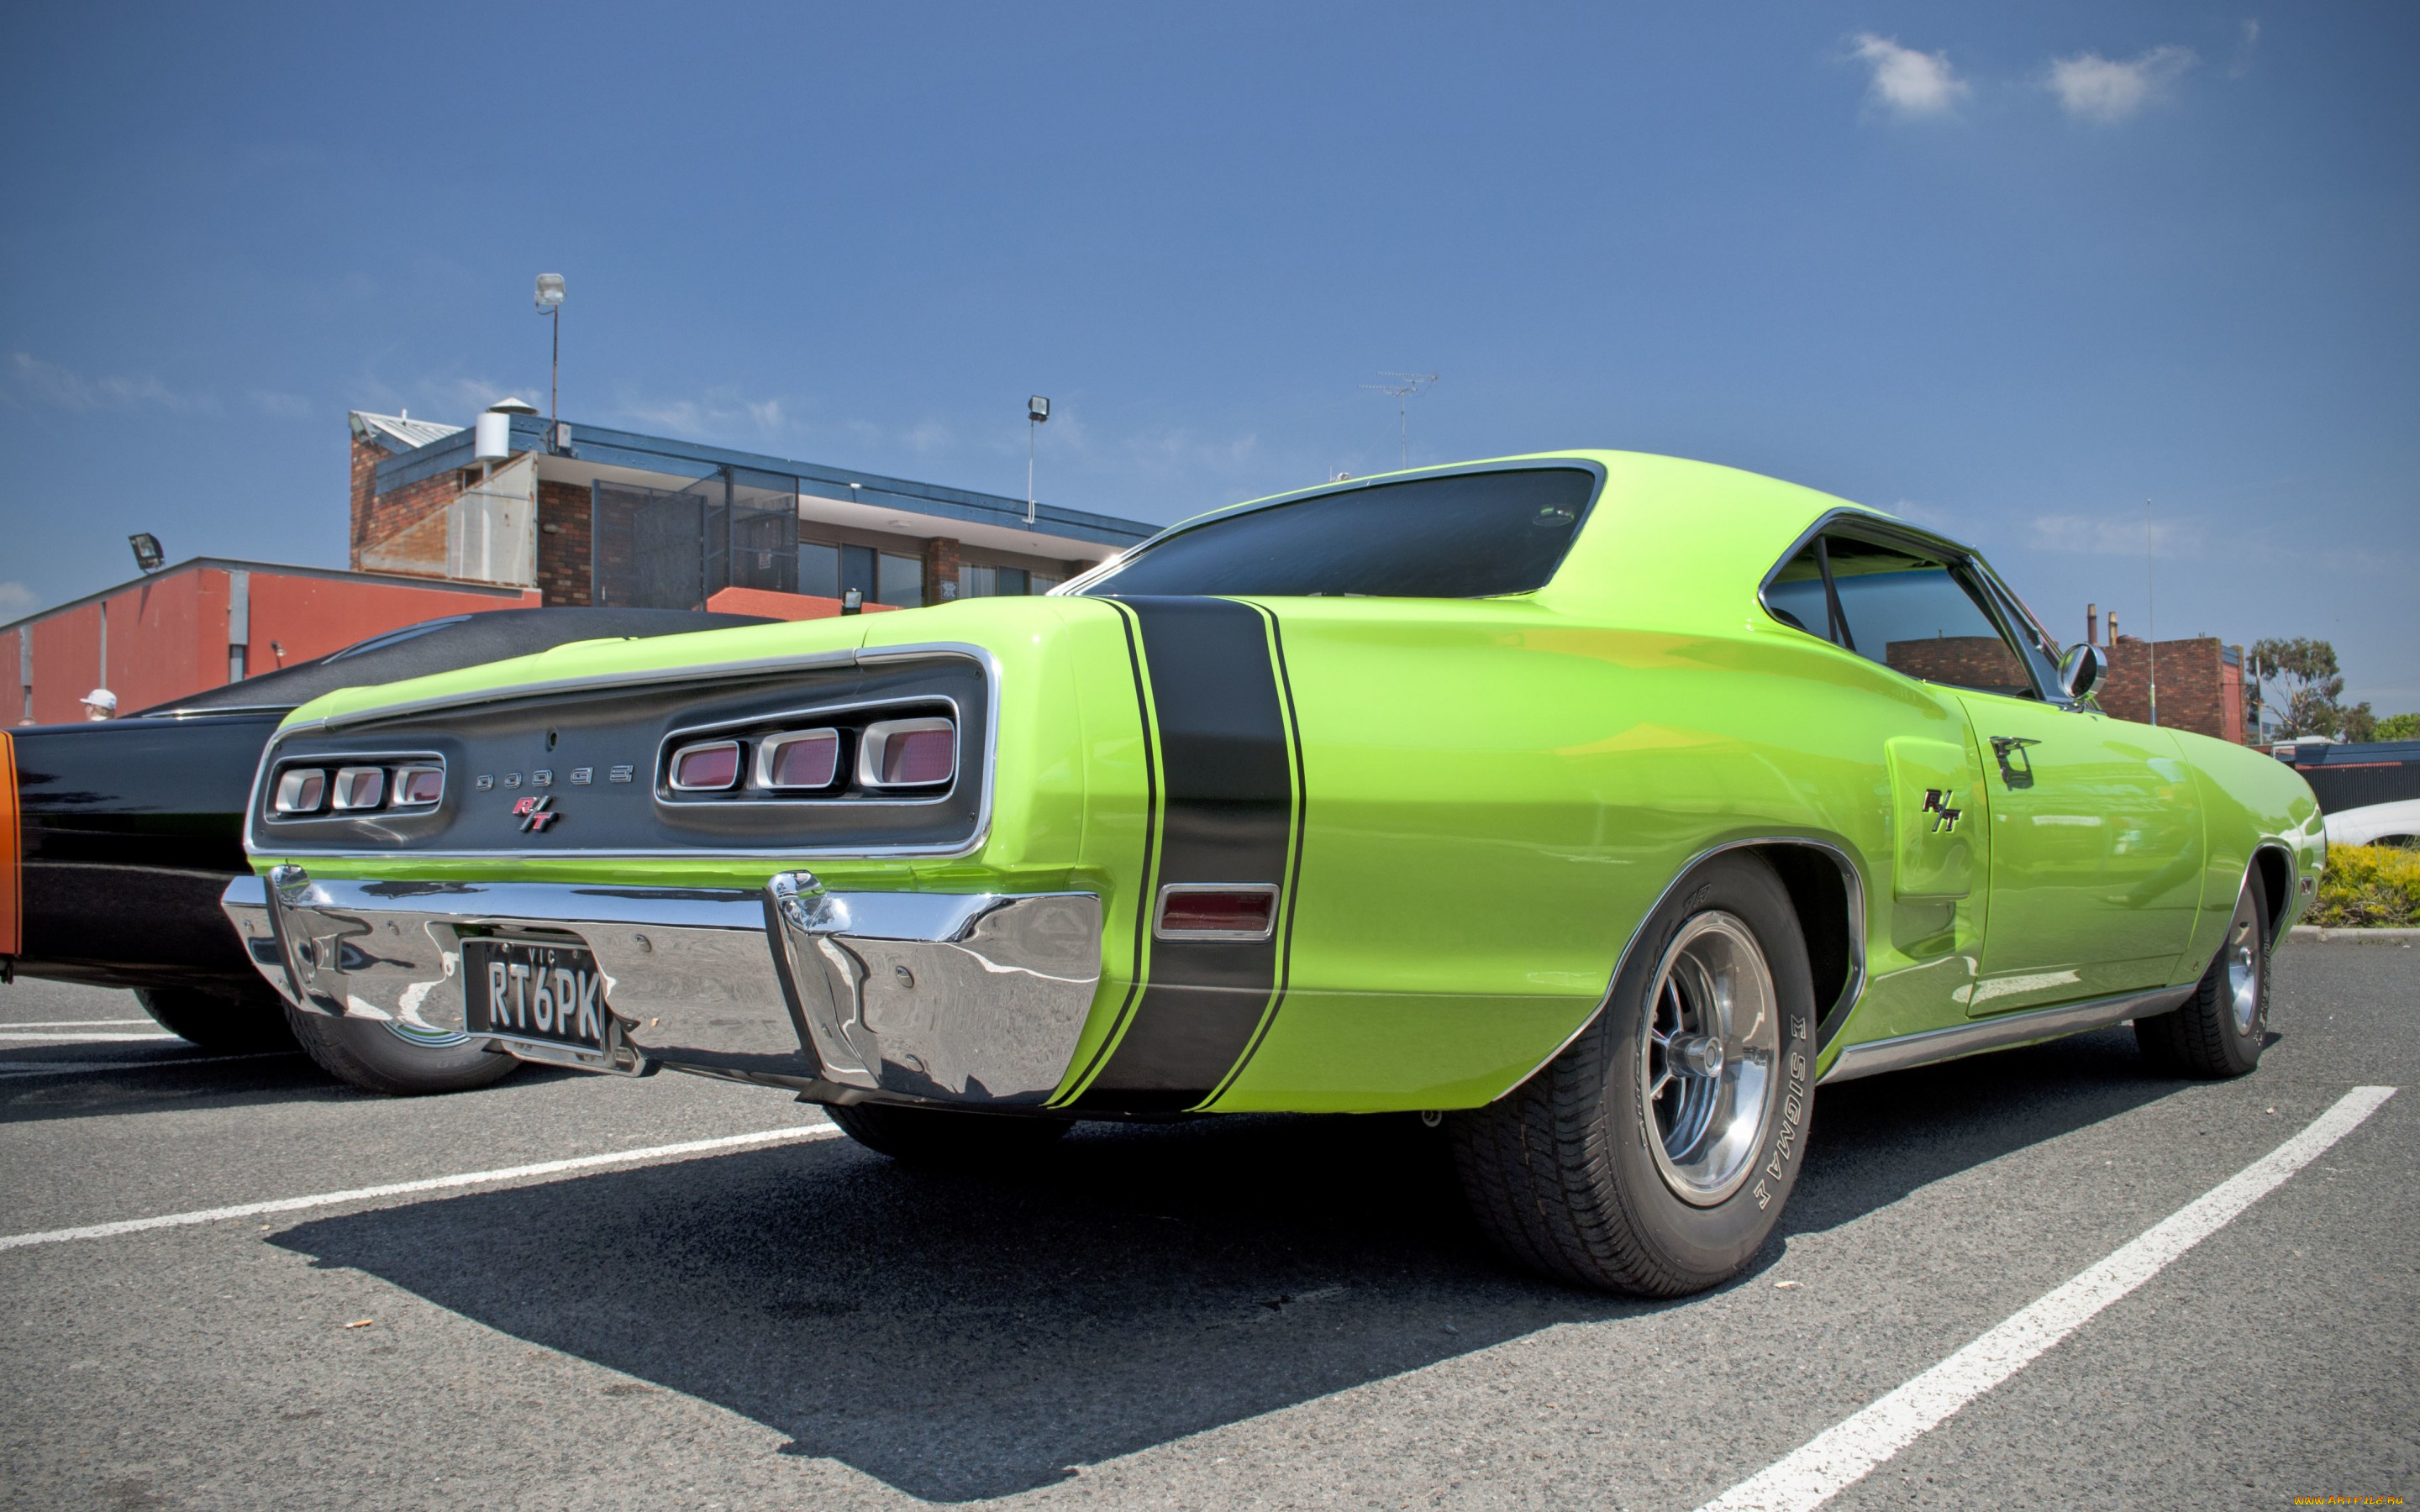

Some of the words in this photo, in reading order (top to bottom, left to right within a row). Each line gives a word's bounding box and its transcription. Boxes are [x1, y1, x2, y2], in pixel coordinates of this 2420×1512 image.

[476, 765, 634, 790] DODGE
[513, 795, 556, 832] R/T
[1923, 789, 1961, 832] R/T
[529, 948, 555, 964] VIC
[488, 963, 601, 1039] RT6PK
[1767, 1052, 1806, 1180] SIGMA
